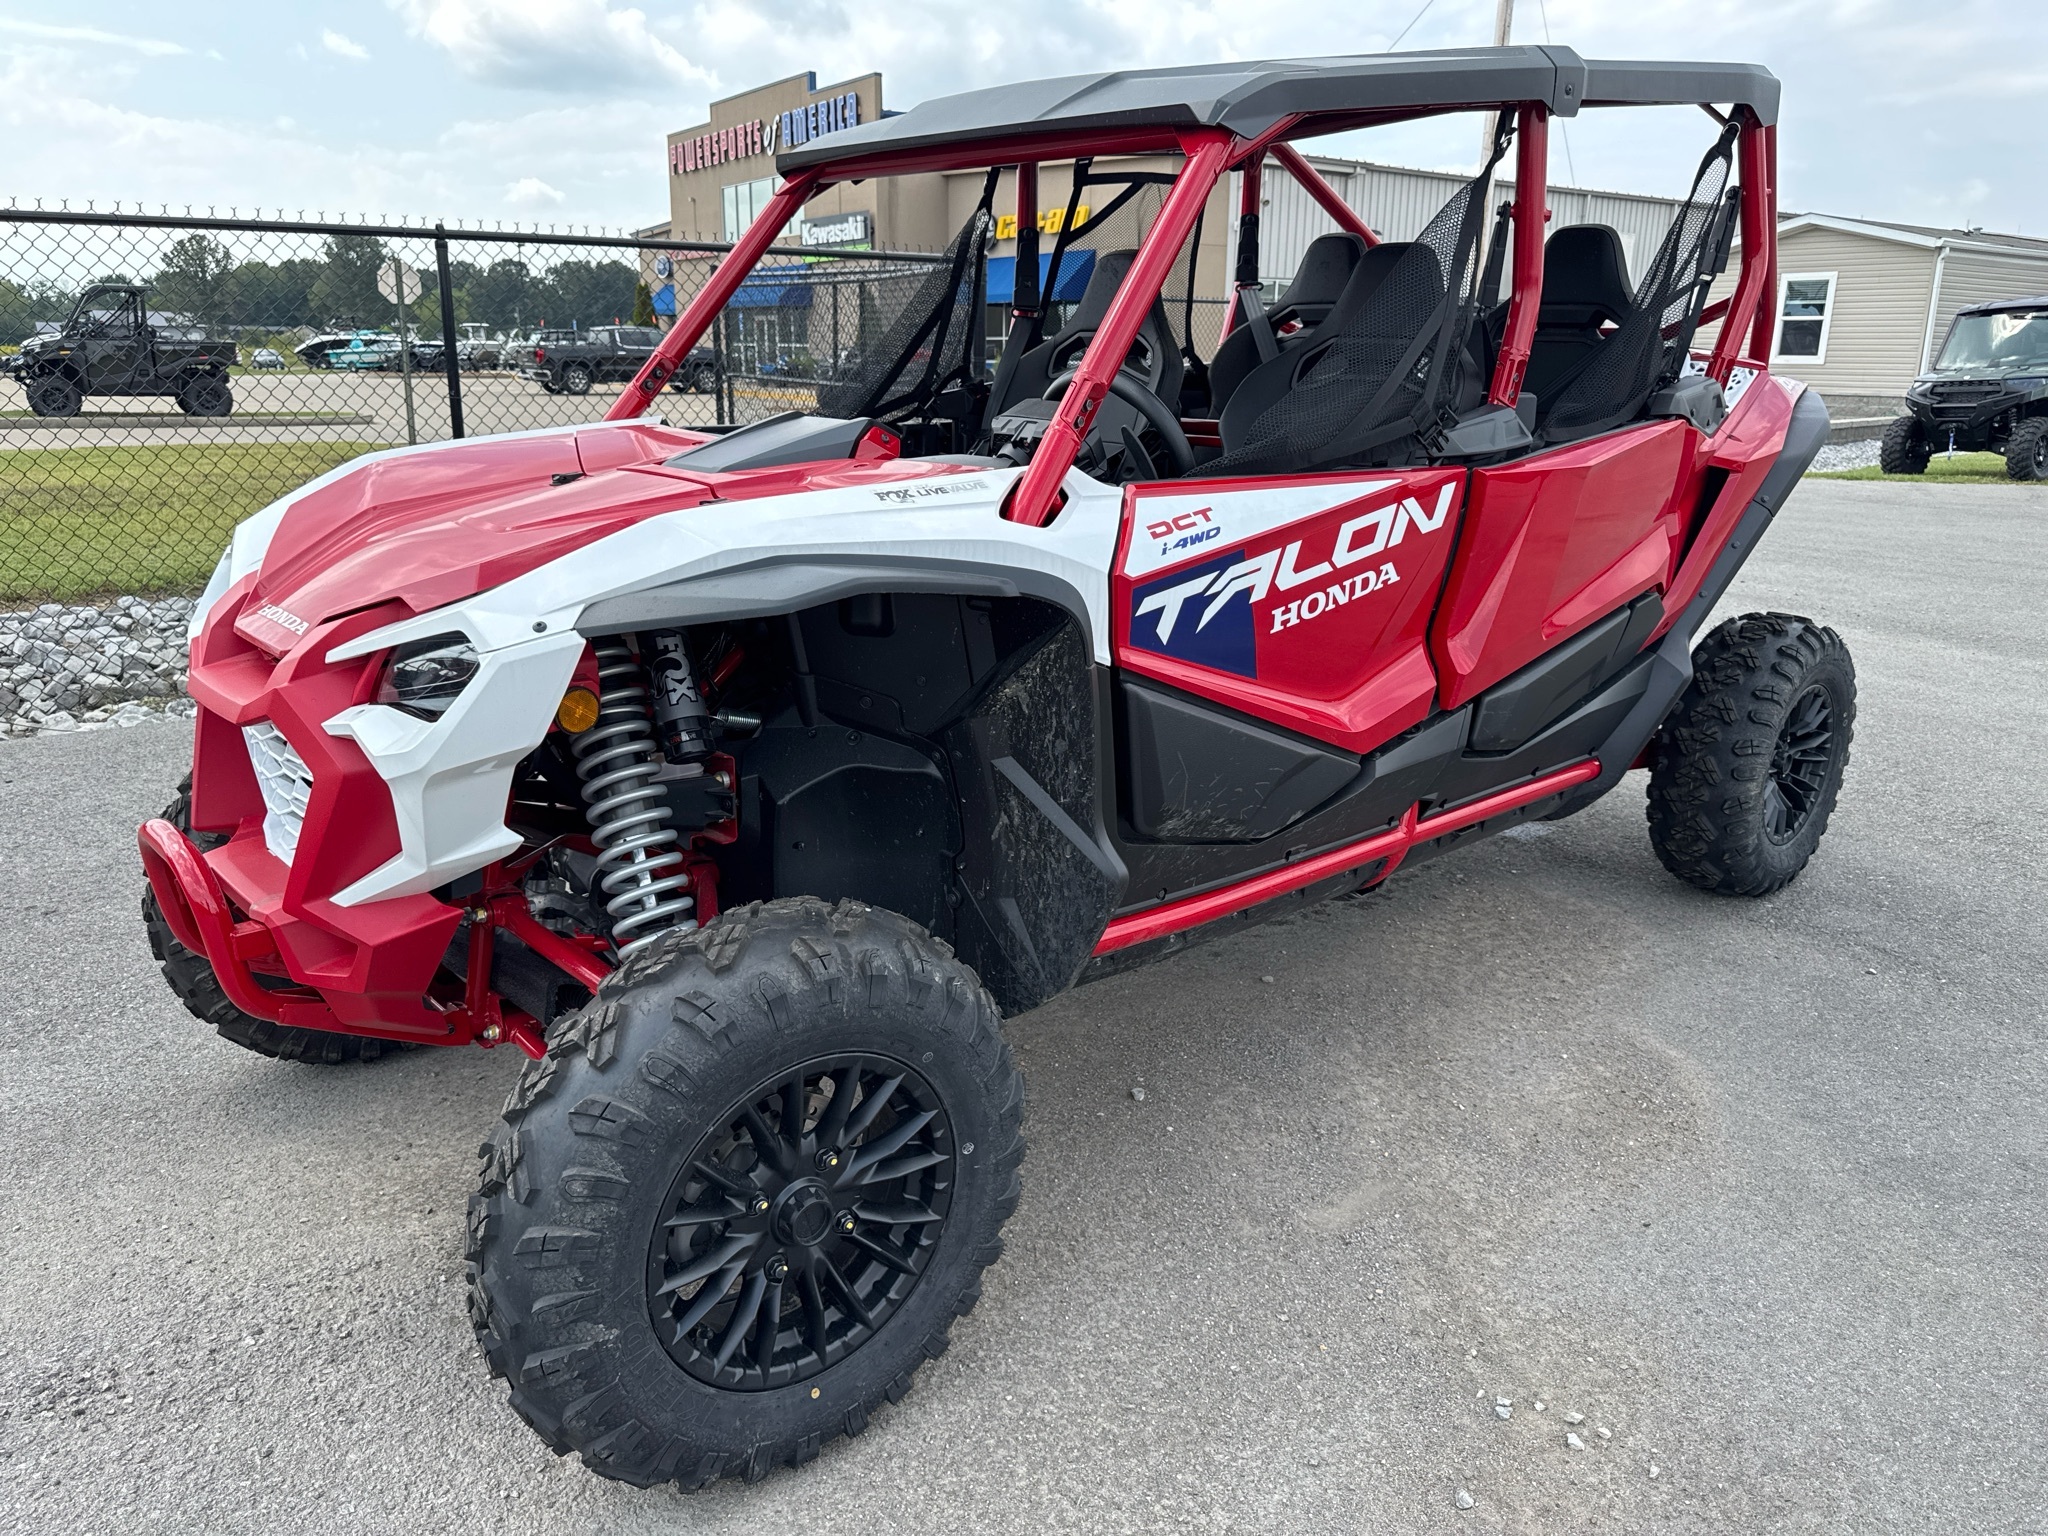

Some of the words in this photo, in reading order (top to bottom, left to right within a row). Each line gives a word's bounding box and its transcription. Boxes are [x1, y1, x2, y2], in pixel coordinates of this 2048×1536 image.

[669, 119, 762, 175] POWERSPORTS
[763, 114, 781, 156] of
[781, 92, 858, 147] AMERICA
[801, 215, 865, 246] Kawasaki
[1146, 506, 1214, 540] DCT
[1161, 526, 1221, 556] i-4WD
[1134, 481, 1457, 646] TALON
[256, 603, 310, 636] HONDA
[1270, 562, 1400, 634] HONDA
[652, 634, 699, 706] FOX
